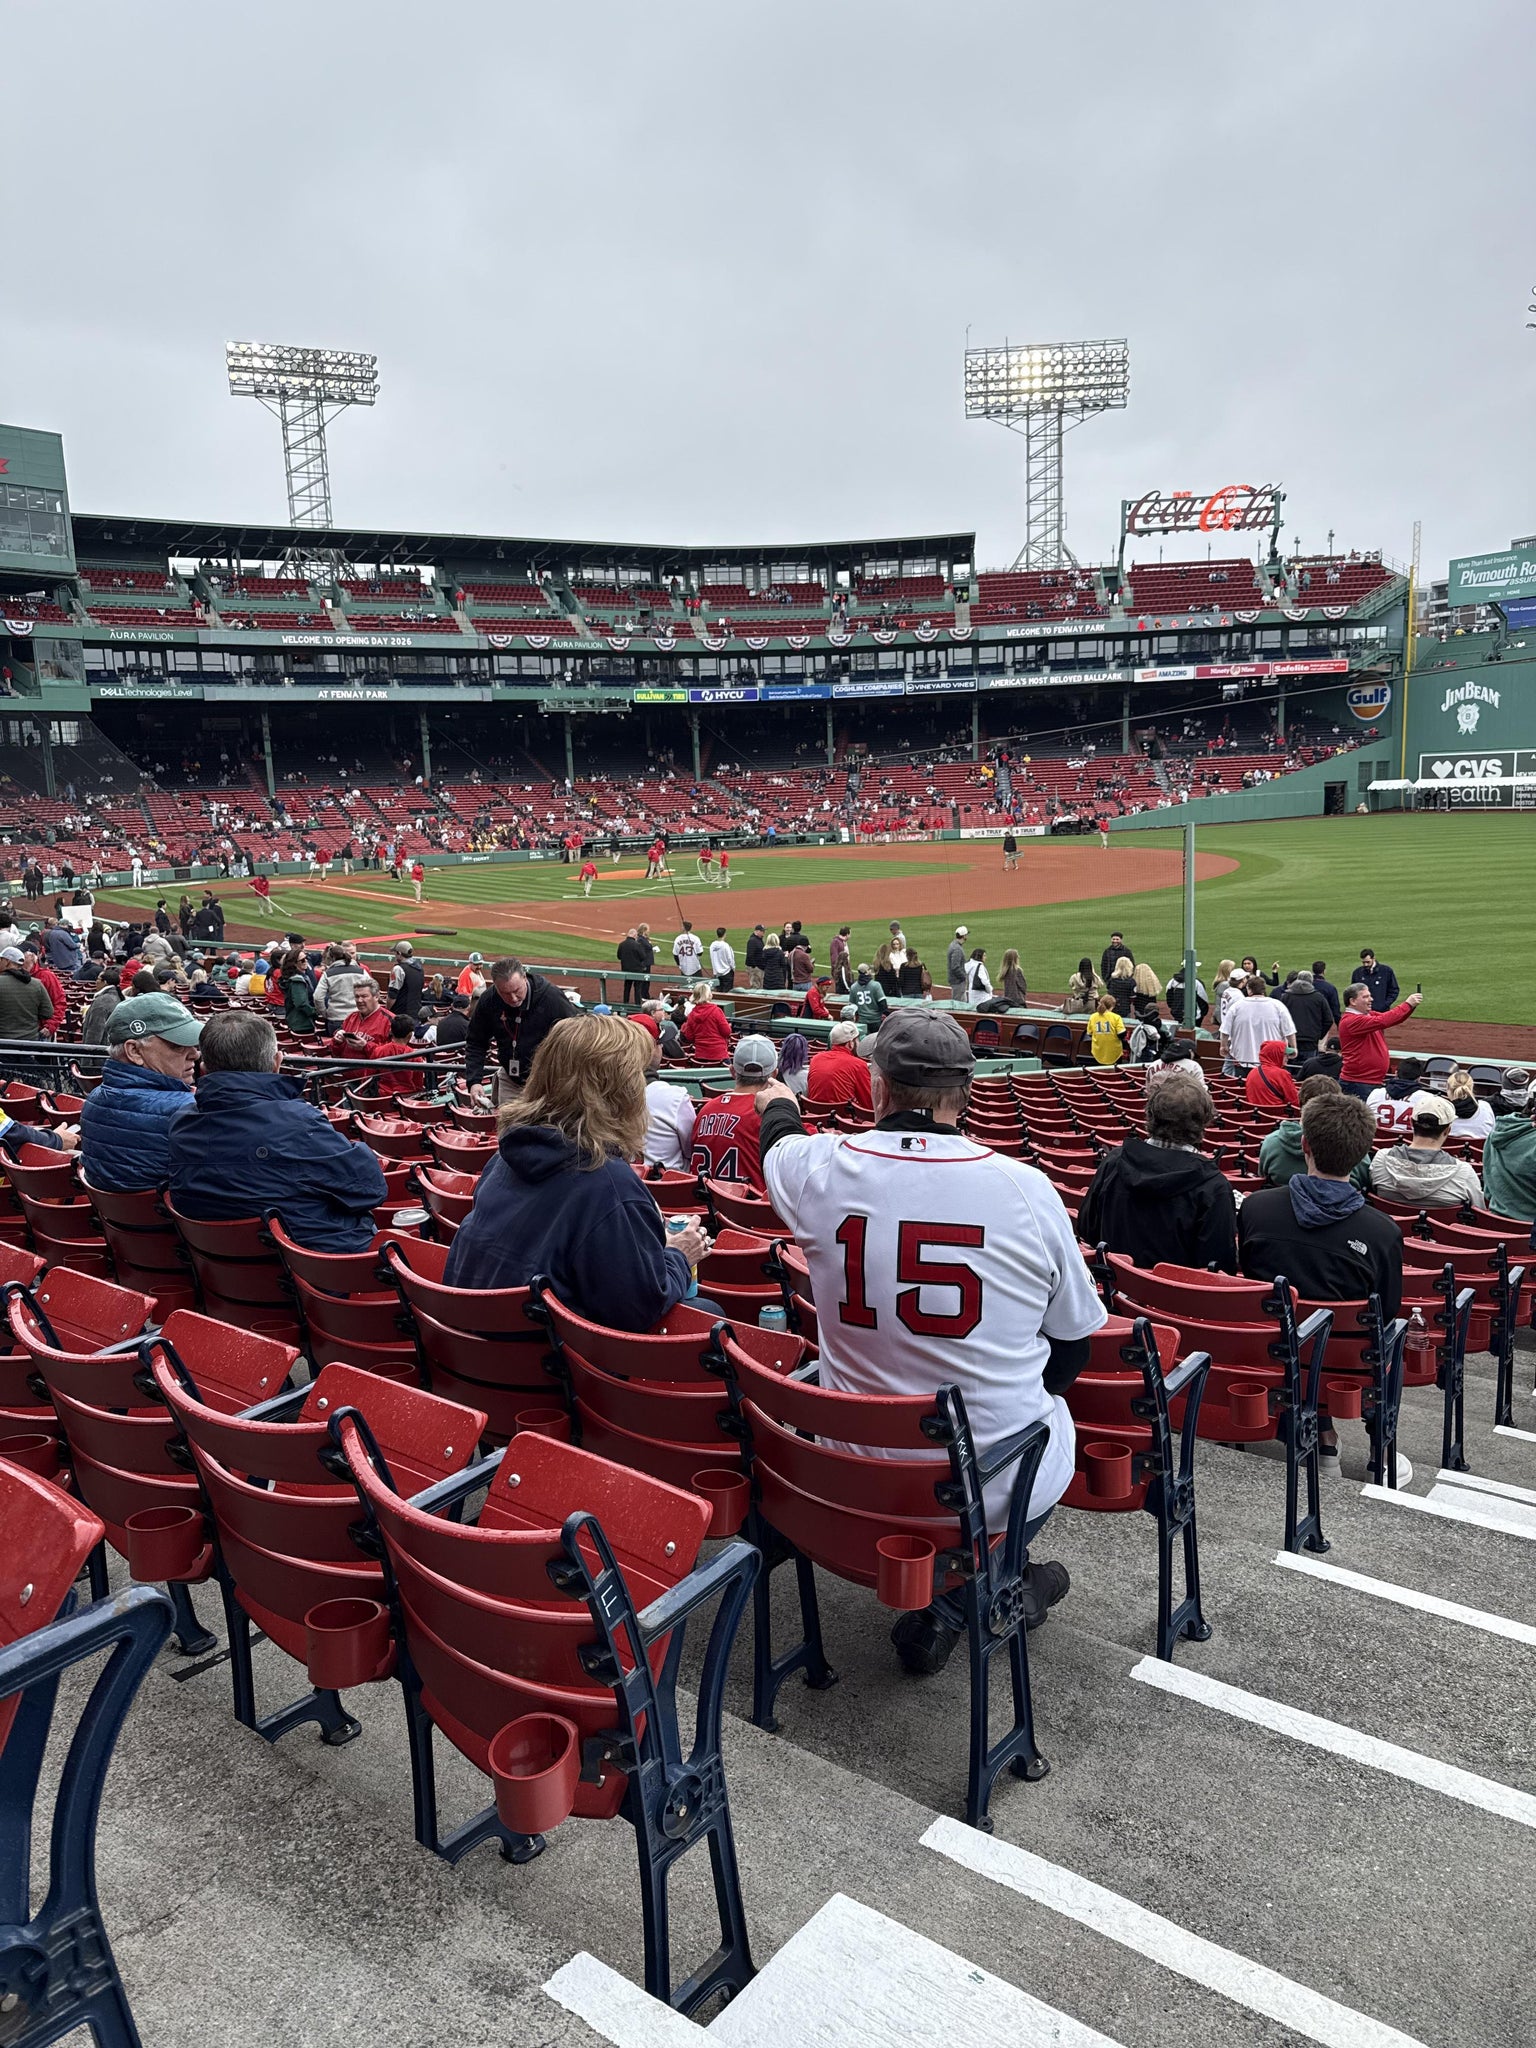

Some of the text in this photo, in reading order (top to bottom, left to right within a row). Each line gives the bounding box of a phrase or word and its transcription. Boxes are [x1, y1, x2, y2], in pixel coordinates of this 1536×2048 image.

[1460, 564, 1518, 585] Plymouth
[138, 632, 174, 640] PAVILION
[1007, 624, 1105, 637] WELCOME TO FENWAY PARK
[282, 635, 412, 646] WELCOME TO OPENING DAY 2026
[1274, 664, 1310, 673] Safelite
[989, 672, 1122, 687] AMERICA'S MOST BELOVED BALLPARK
[100, 687, 192, 698] DELL Technologies Level
[864, 683, 904, 691] COMPANIES
[318, 690, 388, 699] AT FENWAY PARK
[636, 692, 665, 700] SULLIVAN
[715, 691, 745, 700] HYCU
[1348, 688, 1388, 705] Gulf
[1454, 759, 1503, 779] CVS
[1435, 785, 1502, 802] ealth
[679, 946, 694, 957] 43
[856, 991, 872, 1005] 35
[133, 1022, 142, 1032] B
[1095, 1021, 1111, 1033] 11
[1377, 1104, 1414, 1130] 34
[698, 1113, 740, 1139] ORTIZ
[691, 1144, 751, 1182] 34
[836, 1214, 985, 1339] 15
